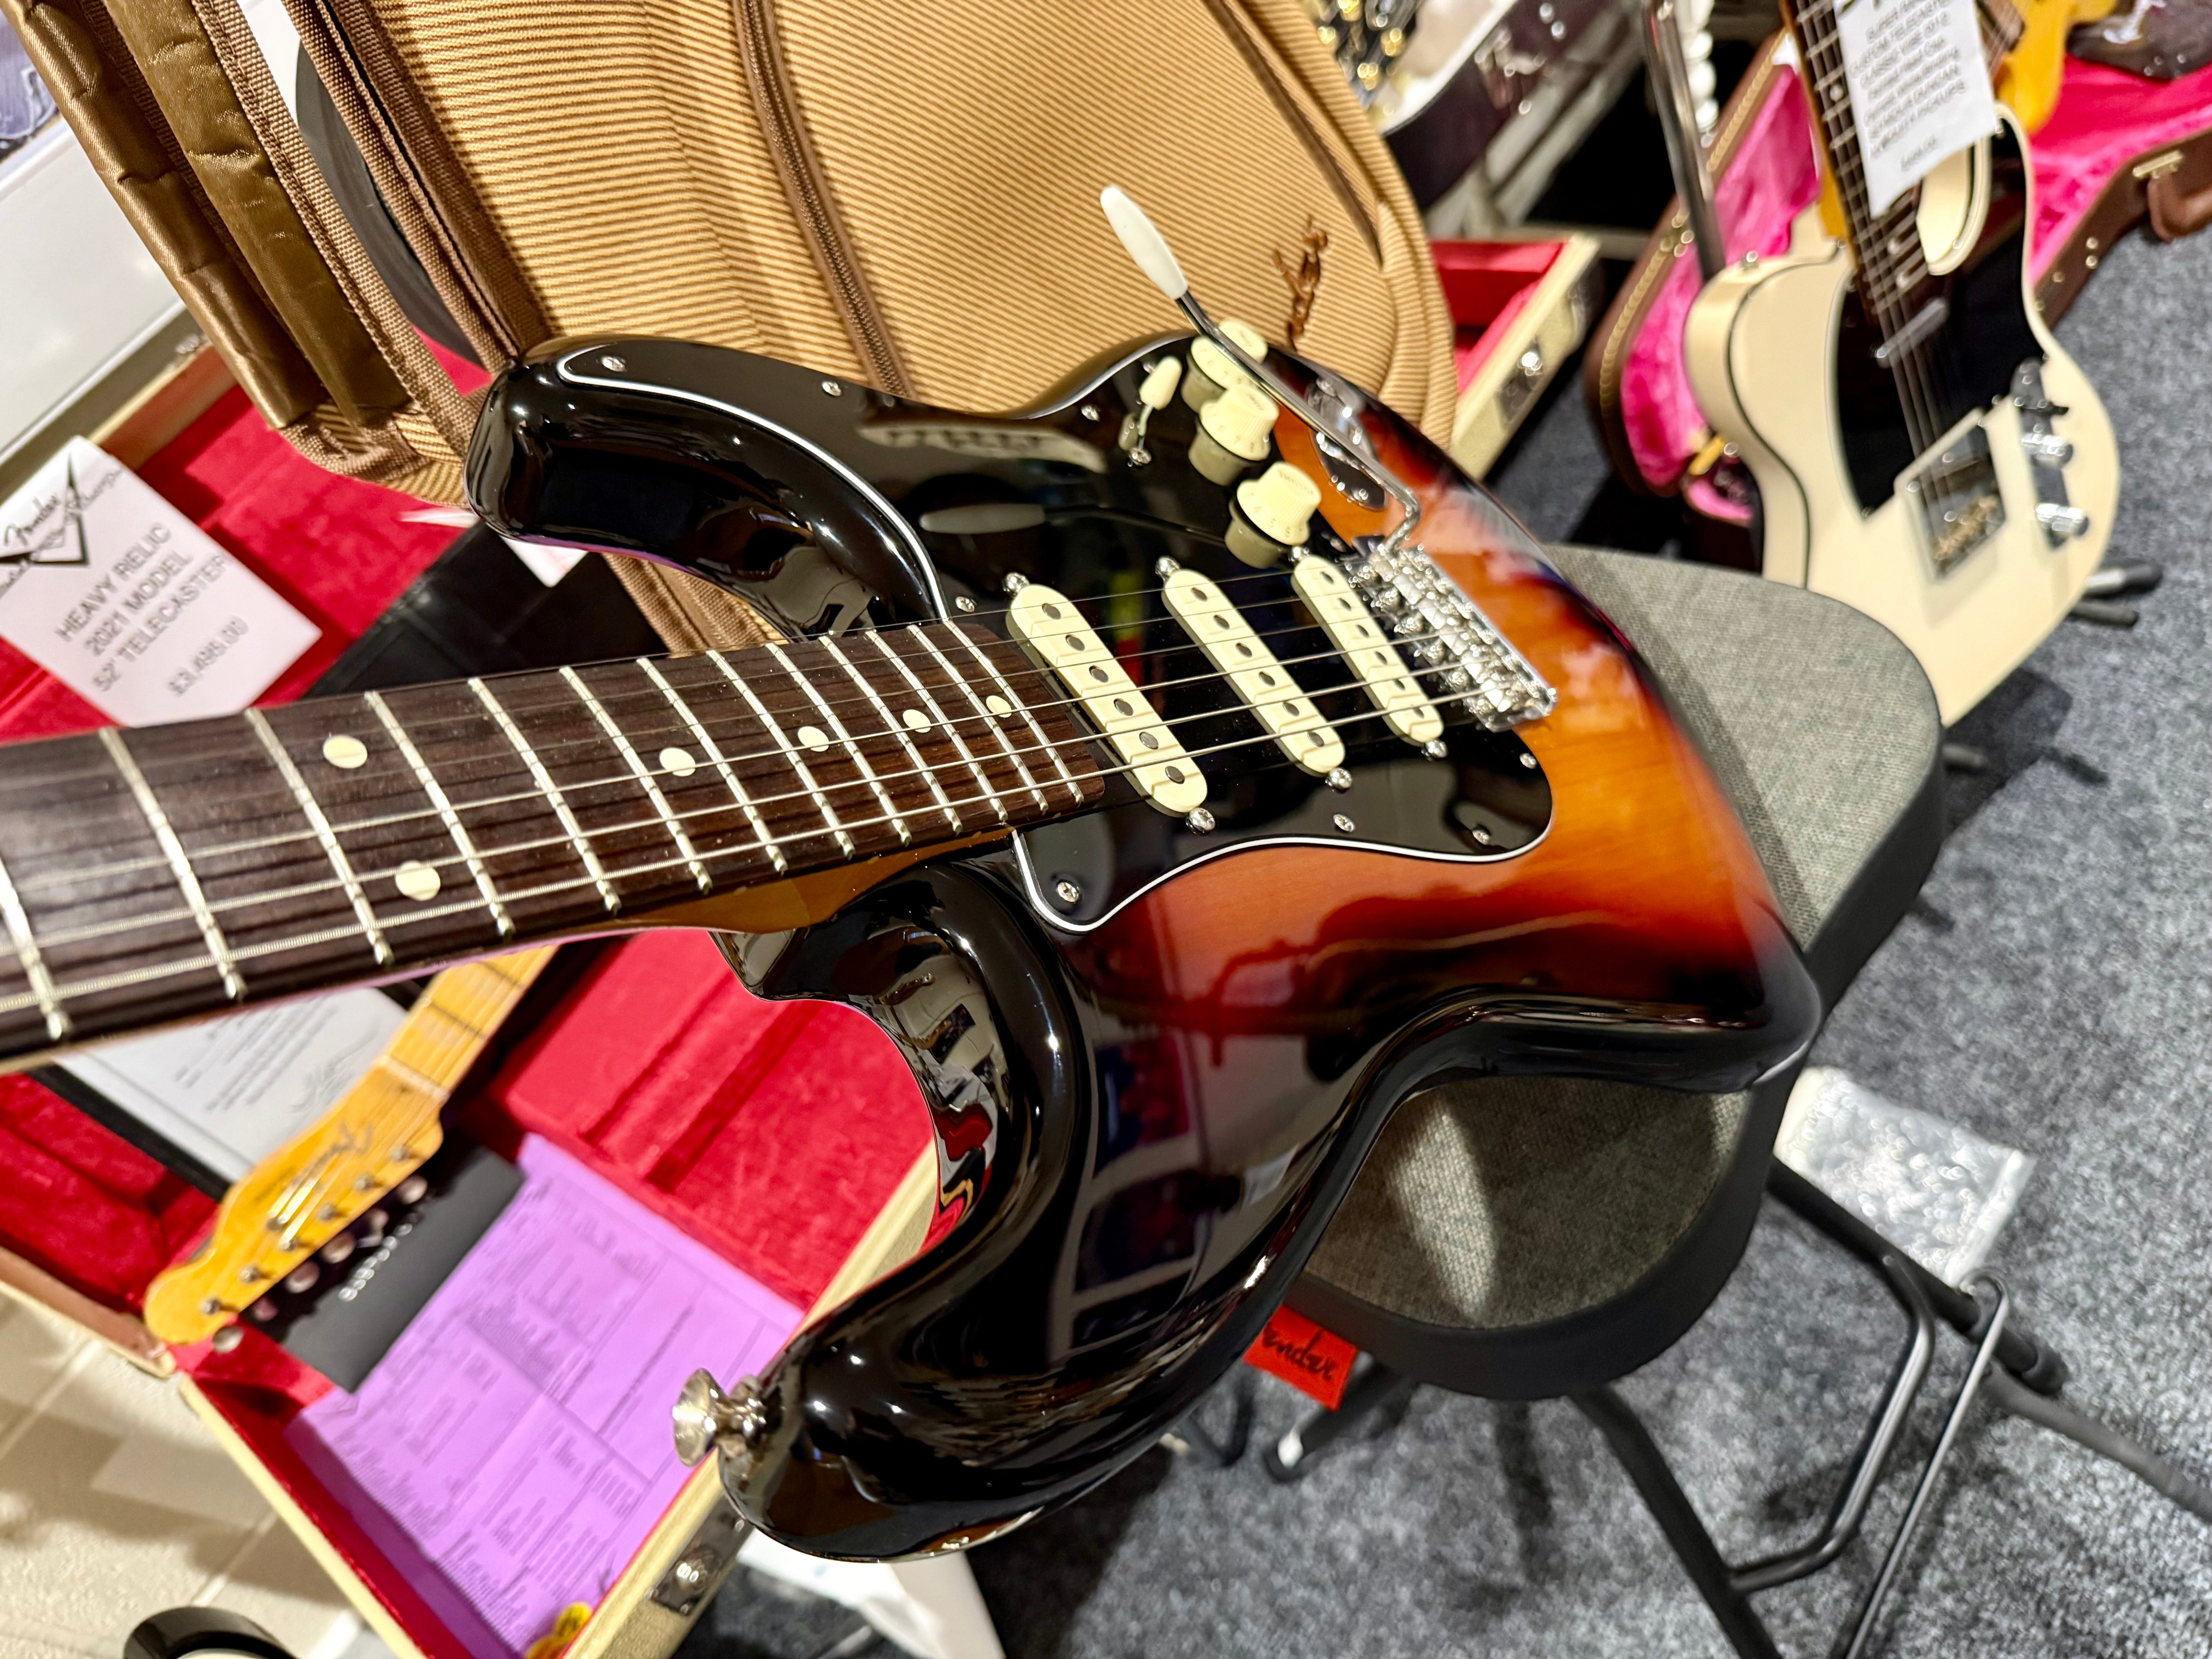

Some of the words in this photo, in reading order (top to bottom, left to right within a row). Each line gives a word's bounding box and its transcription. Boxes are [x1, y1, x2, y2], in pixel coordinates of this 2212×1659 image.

[55, 579, 118, 642] HEAVY
[112, 522, 173, 581] RELIC
[85, 610, 129, 656] 2021
[122, 551, 193, 614] MODEL
[118, 554, 228, 663] TELECASTER
[1262, 1322, 1337, 1381] ender
